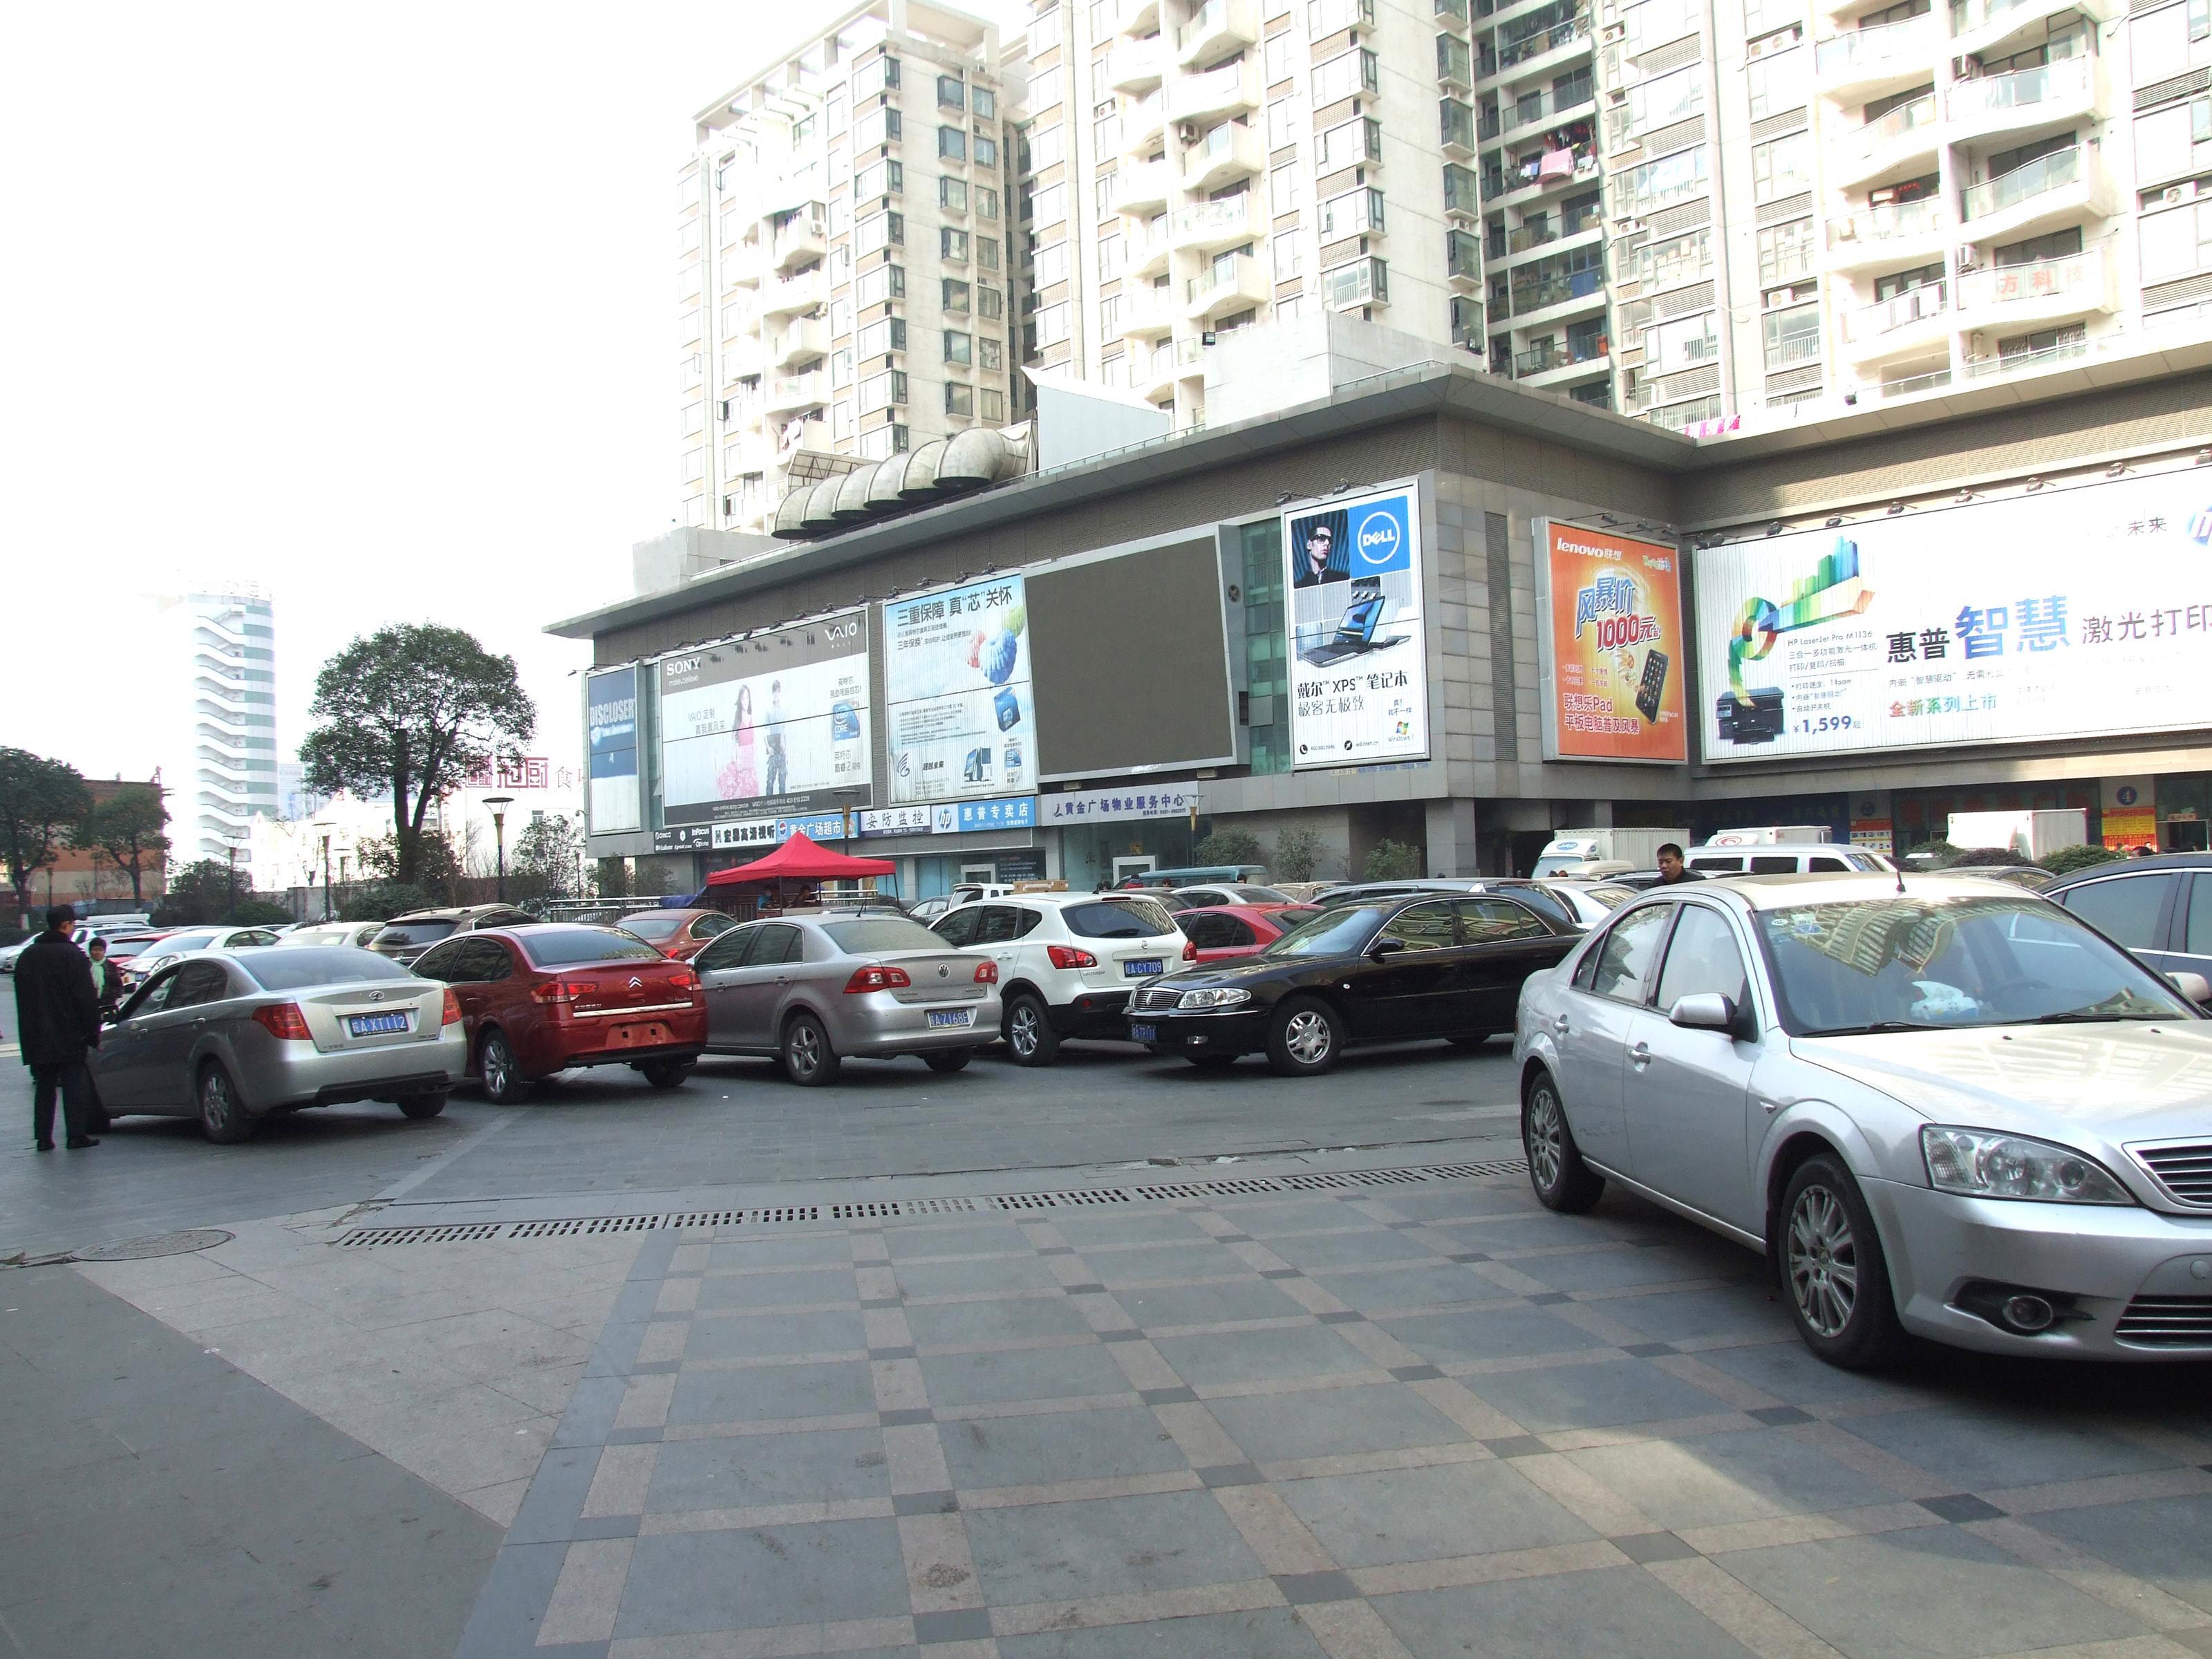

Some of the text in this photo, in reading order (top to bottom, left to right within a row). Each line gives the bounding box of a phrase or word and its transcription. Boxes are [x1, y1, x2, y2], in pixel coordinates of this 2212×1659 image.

[1362, 527, 1395, 548] DELL
[897, 600, 945, 627] 三重保障
[1575, 577, 1634, 639] 风暴价
[824, 622, 857, 641] VAIO
[1788, 630, 1873, 647] HP LaserJet Pro M1136
[666, 657, 701, 676] SONY
[1367, 670, 1408, 690] 笔记本
[1297, 695, 1365, 718] 极客无极致
[1889, 693, 1997, 718] 全新系列上市
[963, 801, 1029, 822] 惠普专卖店
[1065, 794, 1185, 816] 黄金广场物业服务中心
[789, 820, 841, 836] 黄金广场超市
[866, 809, 924, 829] 安防监控
[939, 809, 952, 830] hp
